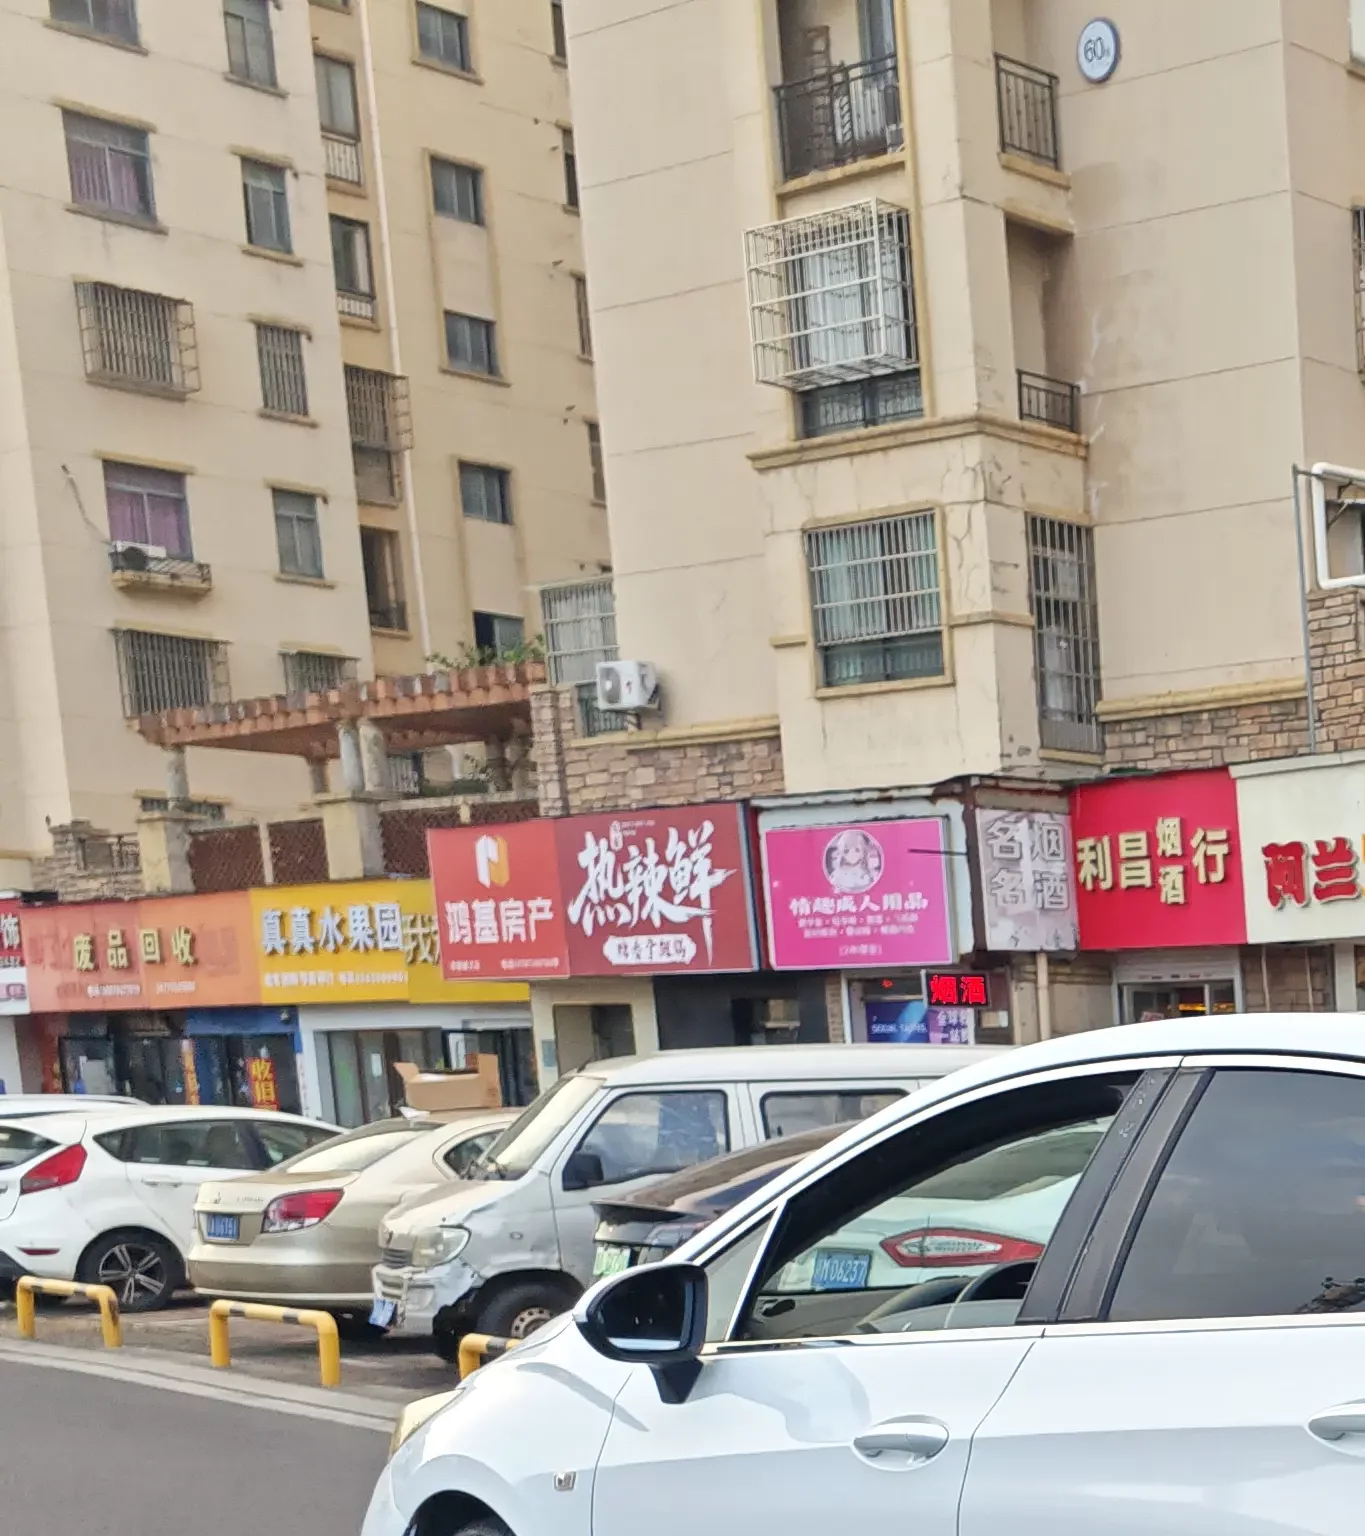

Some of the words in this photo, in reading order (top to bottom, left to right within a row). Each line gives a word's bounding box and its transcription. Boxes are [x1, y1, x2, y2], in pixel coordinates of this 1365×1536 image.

[567, 818, 738, 968] 热辣鲜
[789, 892, 929, 916] 情趣成人用品
[74, 926, 198, 972] 废品回收
[262, 903, 403, 957] 真真水果园
[930, 975, 986, 1005] 烟酒
